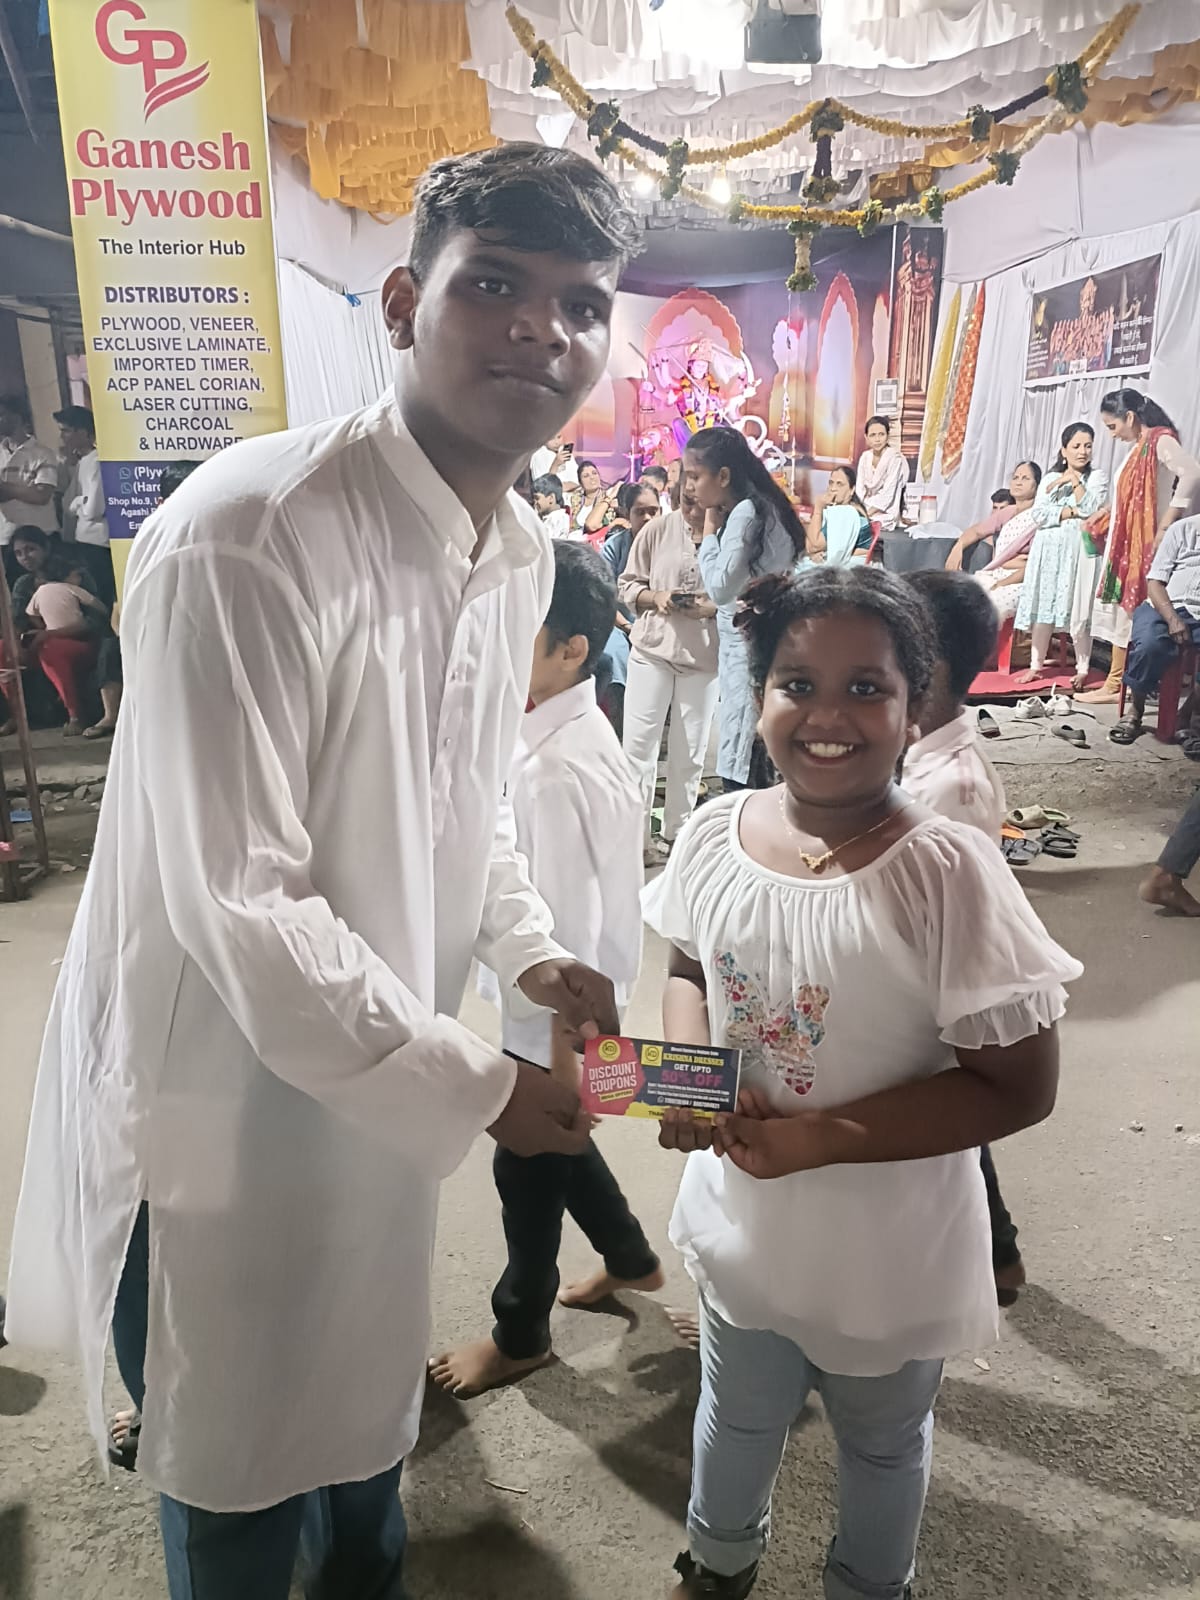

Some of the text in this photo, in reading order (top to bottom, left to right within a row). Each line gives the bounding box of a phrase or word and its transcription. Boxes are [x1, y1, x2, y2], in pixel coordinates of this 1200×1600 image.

[76, 129, 251, 170] Ganesh
[72, 178, 263, 226] Plywood
[98, 238, 246, 256] The Interior Hub
[101, 317, 259, 334] PLYWOOD, VENEER,
[93, 337, 271, 354] EXCLUSIVE LAMINATE,
[114, 357, 254, 374] IMPORTED TIMER,
[107, 377, 265, 394] ACP PANEL CORIAN,
[122, 397, 253, 413] LASER CUTTING,
[145, 417, 234, 431] CHARCOAL
[139, 437, 150, 451] &
[108, 497, 130, 507] Shop
[131, 497, 153, 506] No.9,
[120, 507, 150, 518] Agashi
[588, 1061, 638, 1081] DISCOUNT
[674, 1063, 712, 1074] GET UPTO
[590, 1075, 638, 1094] COUPONS
[661, 1069, 724, 1088] 50% OFF
